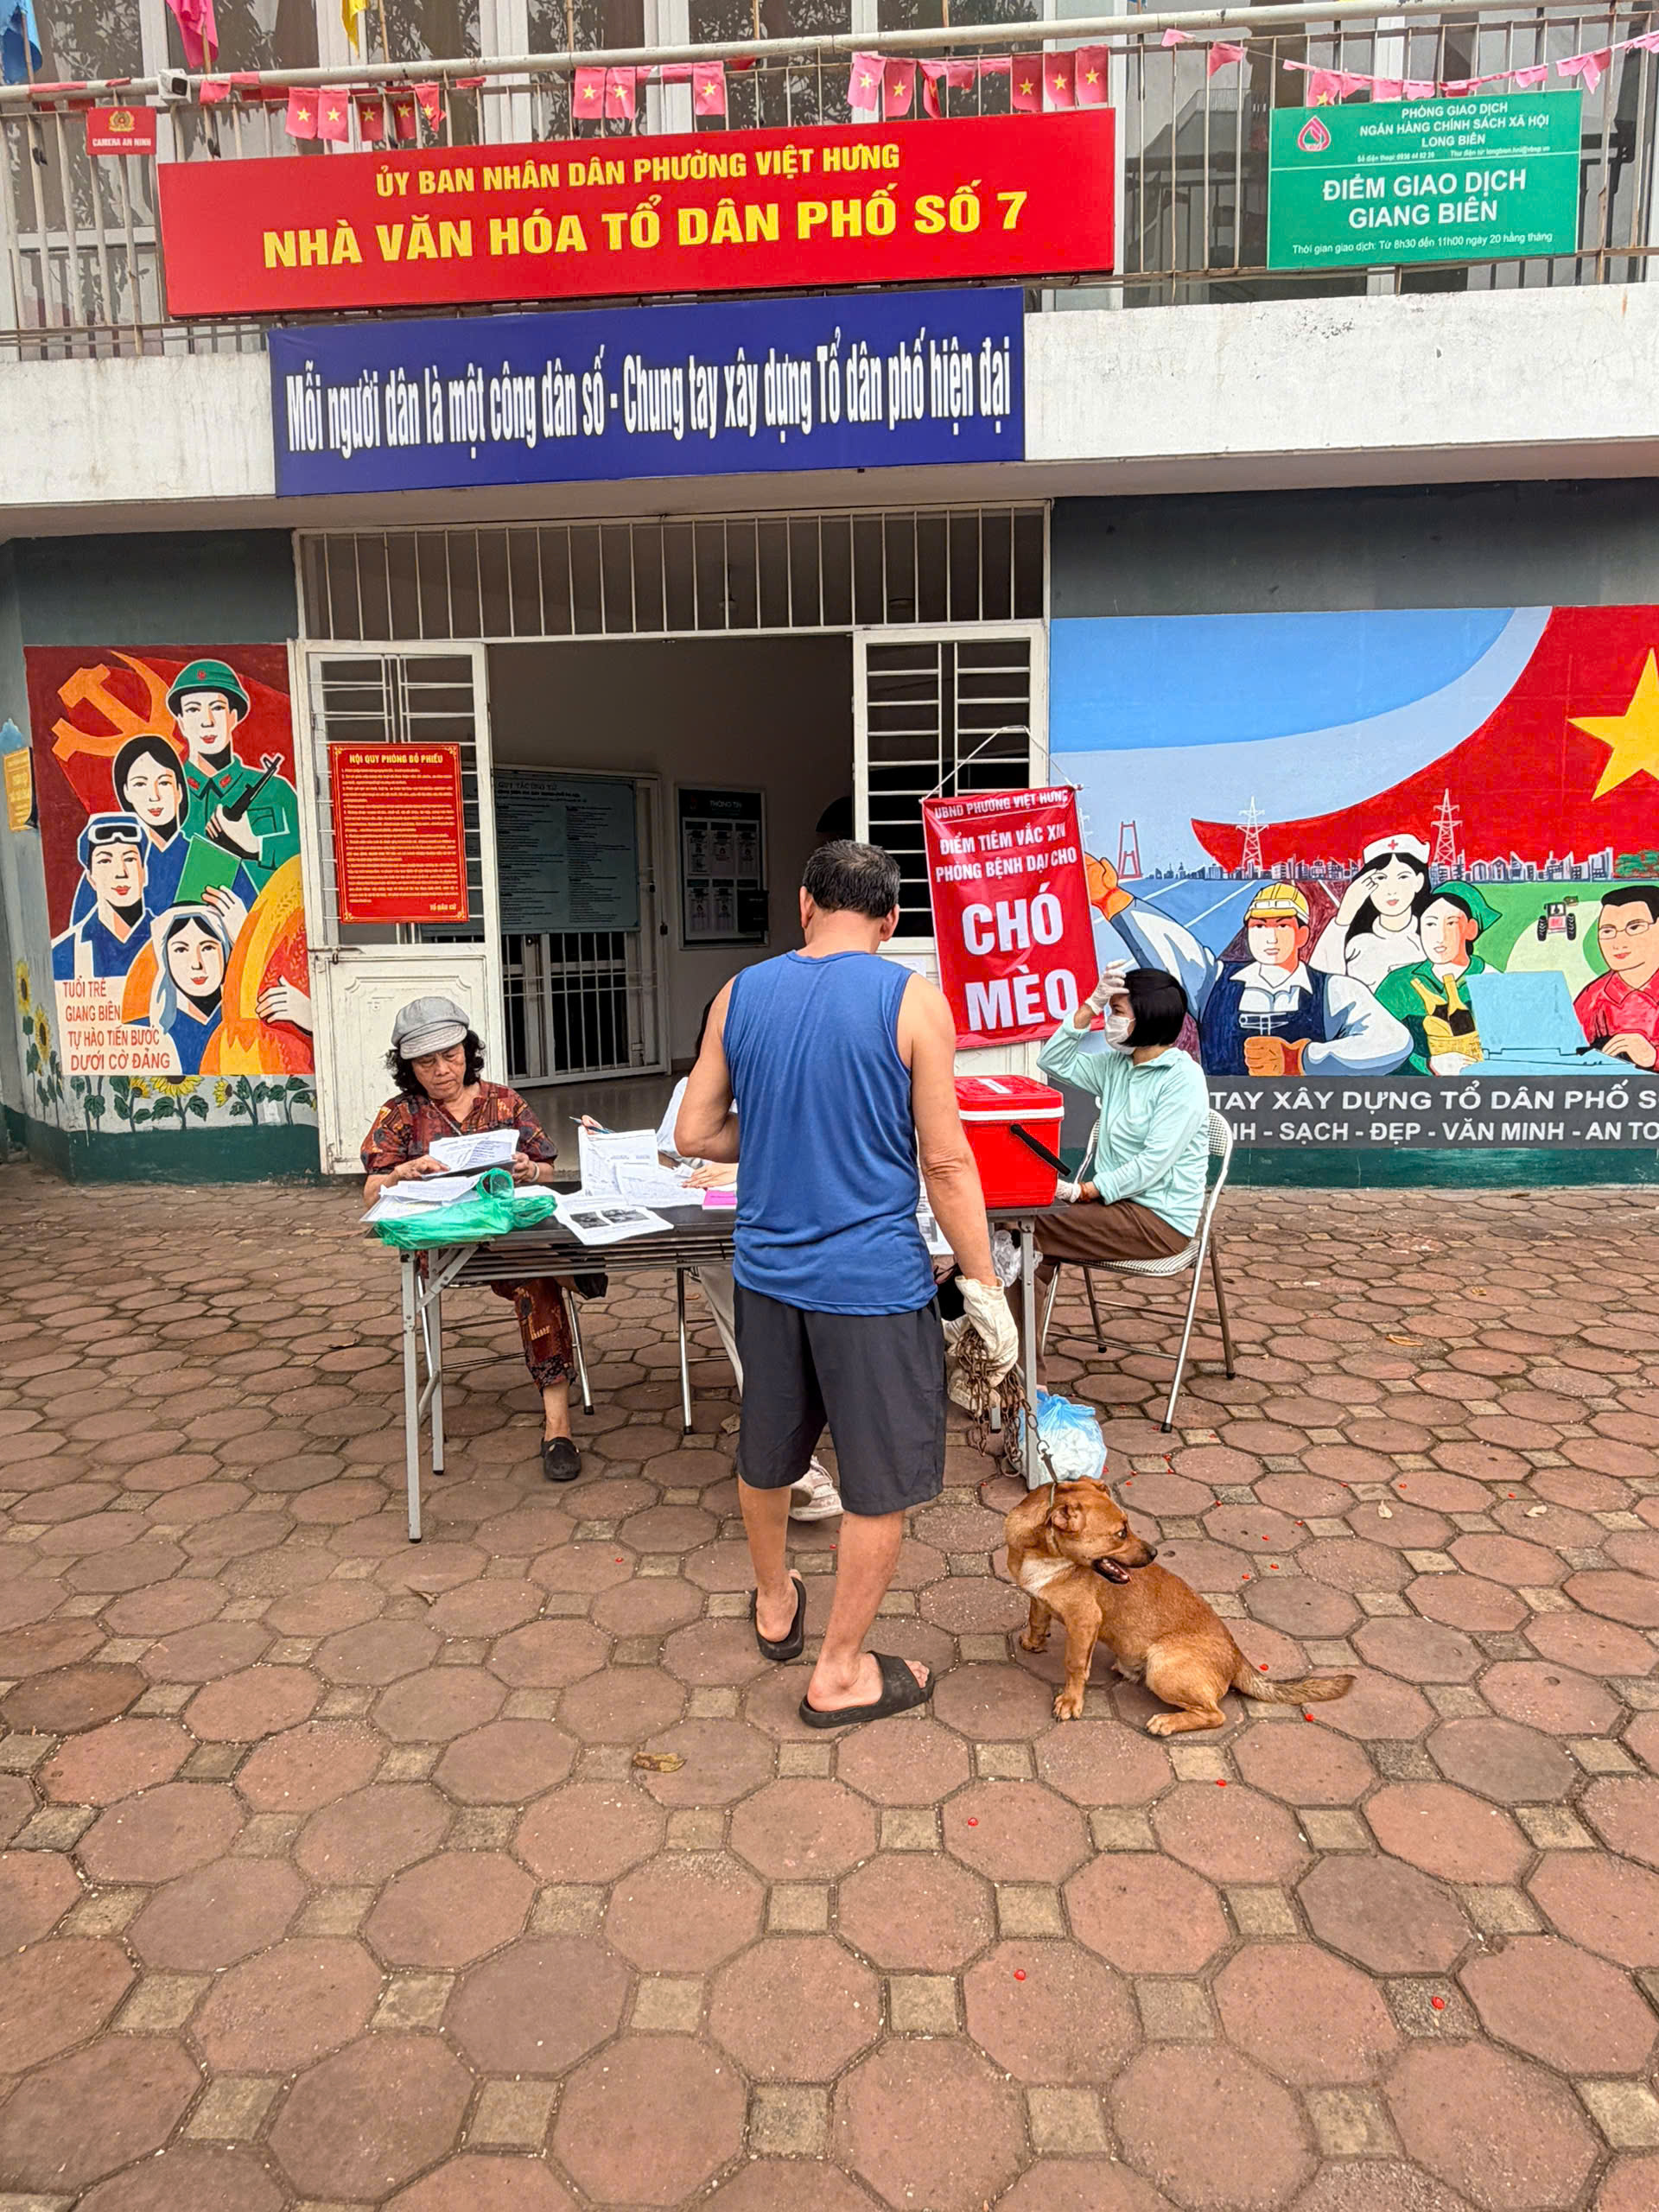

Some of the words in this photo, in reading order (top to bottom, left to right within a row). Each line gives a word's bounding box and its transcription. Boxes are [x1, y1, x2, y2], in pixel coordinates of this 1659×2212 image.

[1402, 105, 1444, 118] PHÒNG
[1446, 105, 1476, 117] GIAO
[1479, 102, 1508, 117] DỊCH
[1359, 122, 1394, 137] NGÂN
[1396, 120, 1431, 135] HÀNG
[1433, 118, 1470, 131] CHÍNH
[1473, 115, 1506, 130] SÁCH
[1509, 114, 1525, 127] XÃ
[1529, 113, 1549, 129] HỘI
[92, 137, 121, 147] CAMERA
[1421, 136, 1455, 148] LONG
[1459, 133, 1486, 146] BIÊN
[376, 165, 410, 196] ỦY
[418, 168, 474, 194] BAN
[483, 159, 560, 191] NHÂN
[569, 156, 625, 187] DÂN
[633, 149, 747, 183] PHƯỜNG
[755, 144, 814, 179] VIỆT
[823, 143, 899, 172] HƯNG
[1323, 173, 1385, 201] ĐIỂM
[1394, 173, 1458, 196] GIAO
[1465, 168, 1526, 198] DỊCH
[263, 219, 363, 269] NHÀ
[376, 214, 473, 261] VĂN
[489, 208, 588, 256] HÓA
[601, 194, 662, 250] TỔ
[677, 198, 779, 246] DÂN
[797, 182, 897, 239] PHỐ
[914, 179, 982, 233] SỐ
[996, 191, 1027, 230] 7
[1349, 205, 1430, 229] GIANG
[1439, 196, 1497, 225] BIÊN
[1314, 245, 1332, 255] gian
[1335, 244, 1354, 254] giao
[1394, 238, 1416, 249] 8h30
[1418, 236, 1434, 248] đến
[1438, 236, 1464, 246] 11h00
[1465, 236, 1488, 247] ngày
[1490, 234, 1501, 244] 20
[1528, 232, 1553, 243] tháng
[286, 359, 323, 452] Mỗi
[327, 369, 381, 459] người
[385, 366, 421, 447] dân
[424, 365, 443, 444] là
[448, 362, 486, 459] một
[490, 360, 536, 448] công
[542, 357, 577, 438] dân
[582, 344, 605, 436] số
[610, 393, 618, 409] -
[624, 354, 683, 441] Chung
[689, 355, 718, 439] tay
[723, 346, 758, 437] xây
[765, 347, 812, 443] dựng
[817, 326, 841, 423] Tổ
[847, 340, 882, 423] dân
[888, 327, 925, 430] phố
[930, 336, 974, 435] hiện
[980, 336, 1010, 434] đại
[349, 753, 363, 765] NỘI
[365, 754, 379, 764] QUY
[381, 753, 407, 764] PHÒNG
[421, 753, 443, 764] PHIẾU
[935, 804, 964, 820] UBND
[1013, 792, 1035, 810] VIỆT
[1039, 790, 1068, 804] HƯNG
[940, 831, 976, 855] ĐIỂM
[978, 827, 1012, 851] TIÊM
[1015, 823, 1044, 846] VẮC
[1047, 823, 1065, 842] XIN
[936, 860, 982, 883] PHÒNG
[985, 857, 1023, 880] BỆNH
[1027, 855, 1048, 874] DẠI
[1051, 847, 1077, 867] CHO
[962, 881, 1064, 956] CHÓ
[63, 975, 85, 997] TUỔI
[88, 977, 106, 997] TRẺ
[964, 964, 1079, 1031] MÈO
[66, 1005, 95, 1021] GIANG
[99, 1001, 120, 1020] BIÊN
[68, 1031, 81, 1050] TỰ
[84, 1027, 104, 1046] HÀO
[107, 1025, 129, 1046] TIẾN
[130, 1025, 159, 1046] BƯỚC
[71, 1050, 104, 1071] DƯỚI
[109, 1049, 129, 1069] CỜ
[132, 1047, 170, 1069] ĐẢNG
[1211, 1091, 1264, 1110] TAY
[1272, 1086, 1334, 1110] XÂY
[1343, 1090, 1432, 1115] DỰNG
[1440, 1080, 1481, 1109] TỔ
[1491, 1086, 1554, 1109] DÂN
[1565, 1079, 1629, 1109] PHỐ
[1638, 1090, 1659, 1109] S
[1280, 1122, 1348, 1145] SẠCH
[1370, 1122, 1421, 1145] ĐẸP
[1442, 1118, 1494, 1141] VĂN
[1501, 1122, 1564, 1141] MINH
[1586, 1122, 1621, 1141] AN
